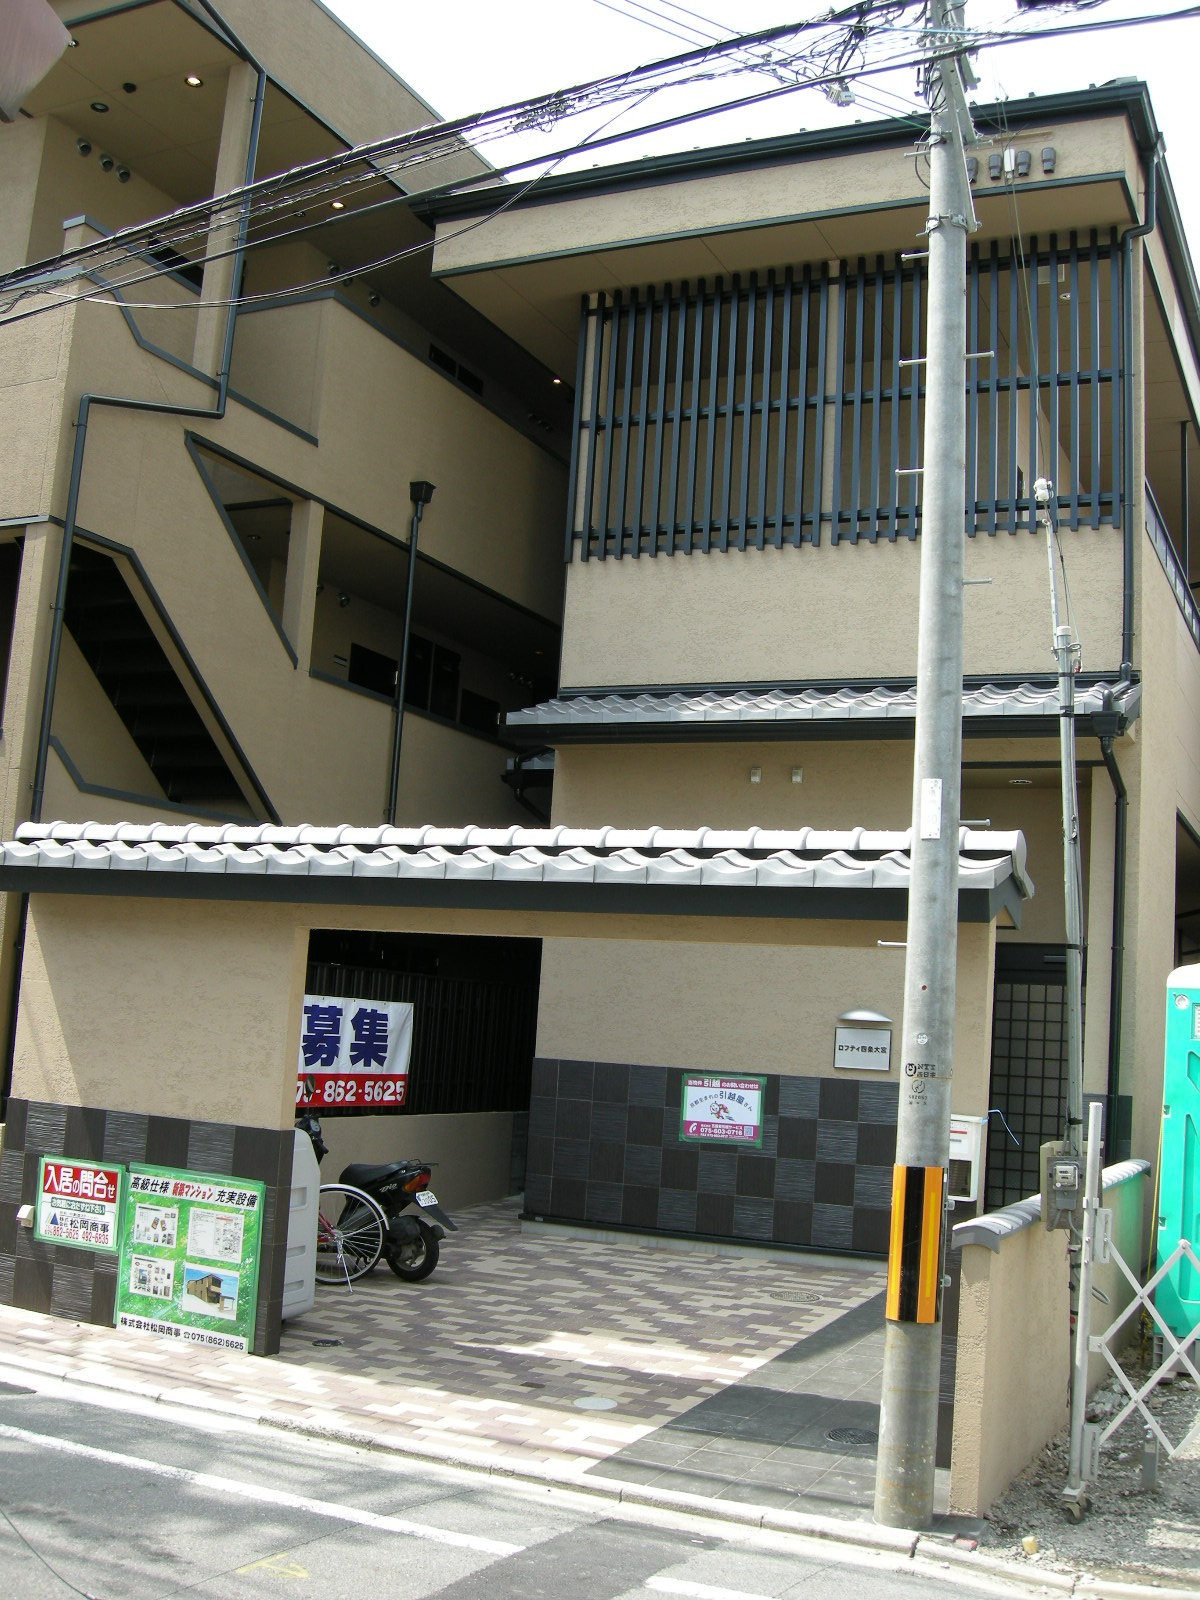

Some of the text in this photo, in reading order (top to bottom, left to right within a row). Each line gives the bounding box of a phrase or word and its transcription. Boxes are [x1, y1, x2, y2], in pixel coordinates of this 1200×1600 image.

[301, 1005, 389, 1067] 募集
[838, 1044, 887, 1053] ロフティ四条大宮
[44, 1165, 115, 1198] 入居の問合せ
[131, 1176, 258, 1207] 高級仕様 新築マンション 充実設備
[69, 1219, 110, 1234] 松岡商事
[120, 1316, 244, 1351] 株式会社松岡商事 075(862)5625
